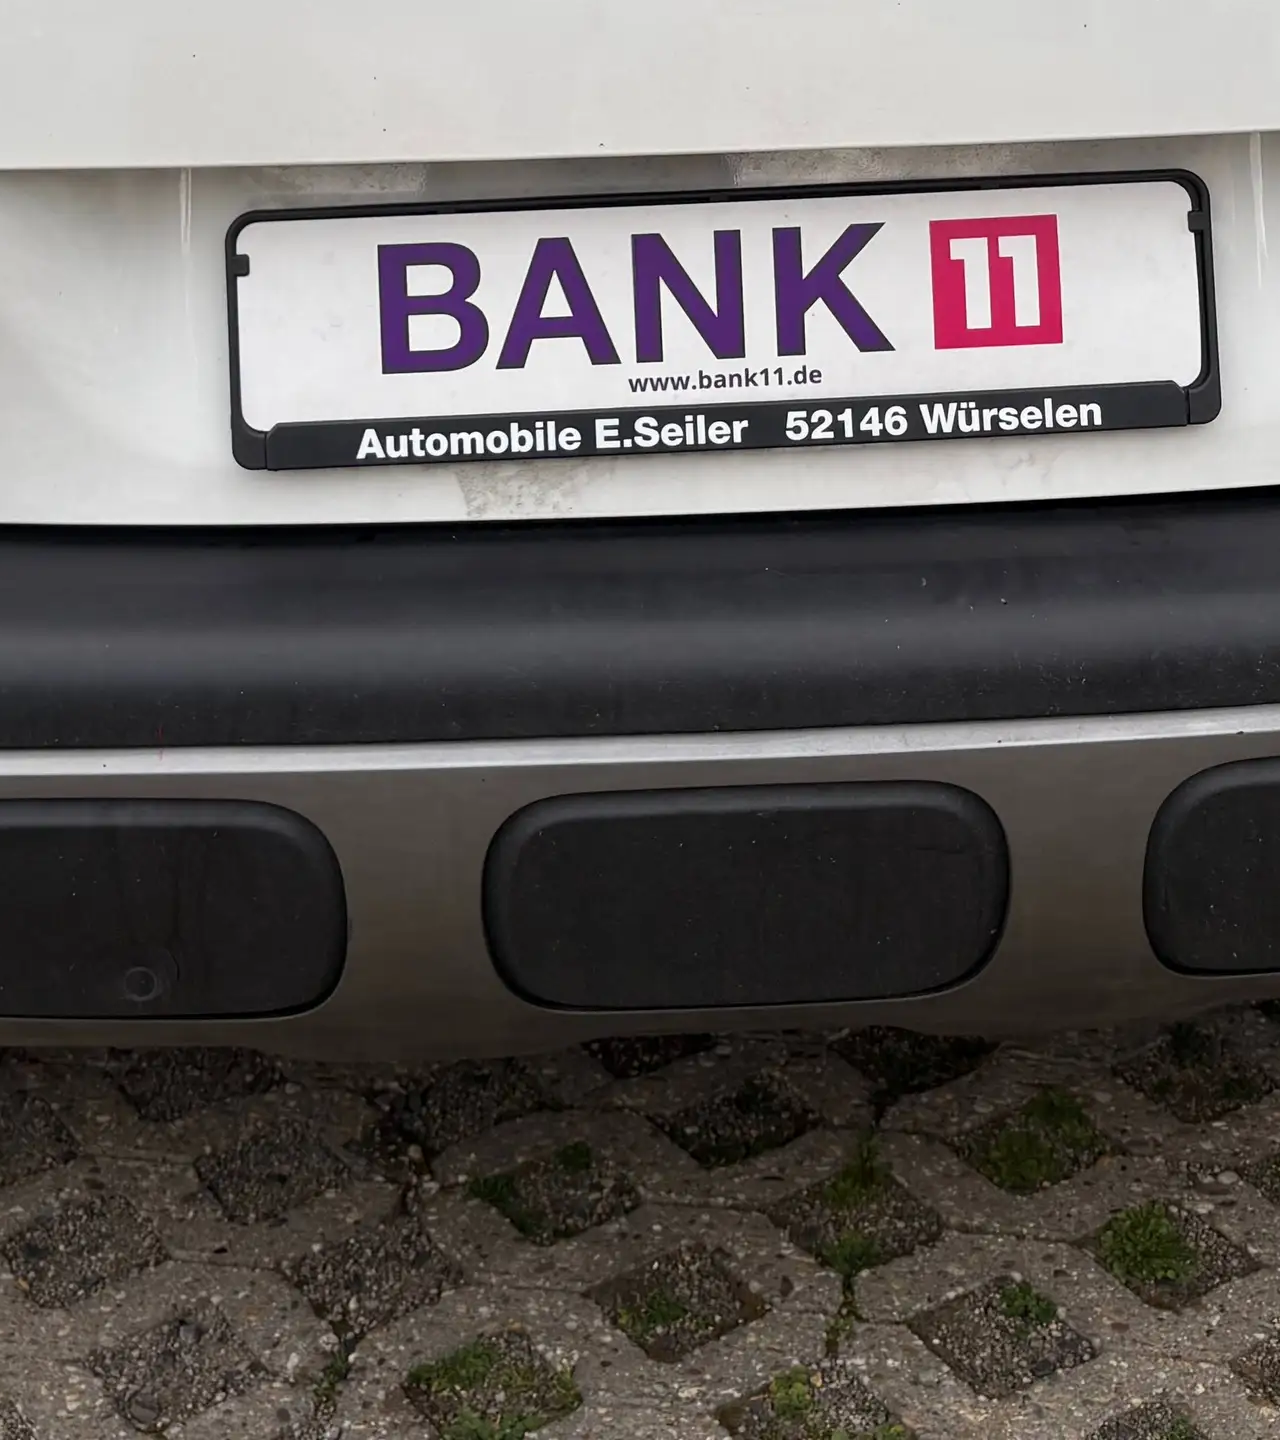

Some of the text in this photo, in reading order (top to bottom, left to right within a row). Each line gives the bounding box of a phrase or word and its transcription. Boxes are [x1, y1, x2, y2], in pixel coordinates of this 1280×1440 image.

[376, 221, 1044, 375] BANK 11
[628, 364, 823, 392] www.bank11.de
[356, 397, 1103, 459] Automobile E.Seiler 52146 Würselen
